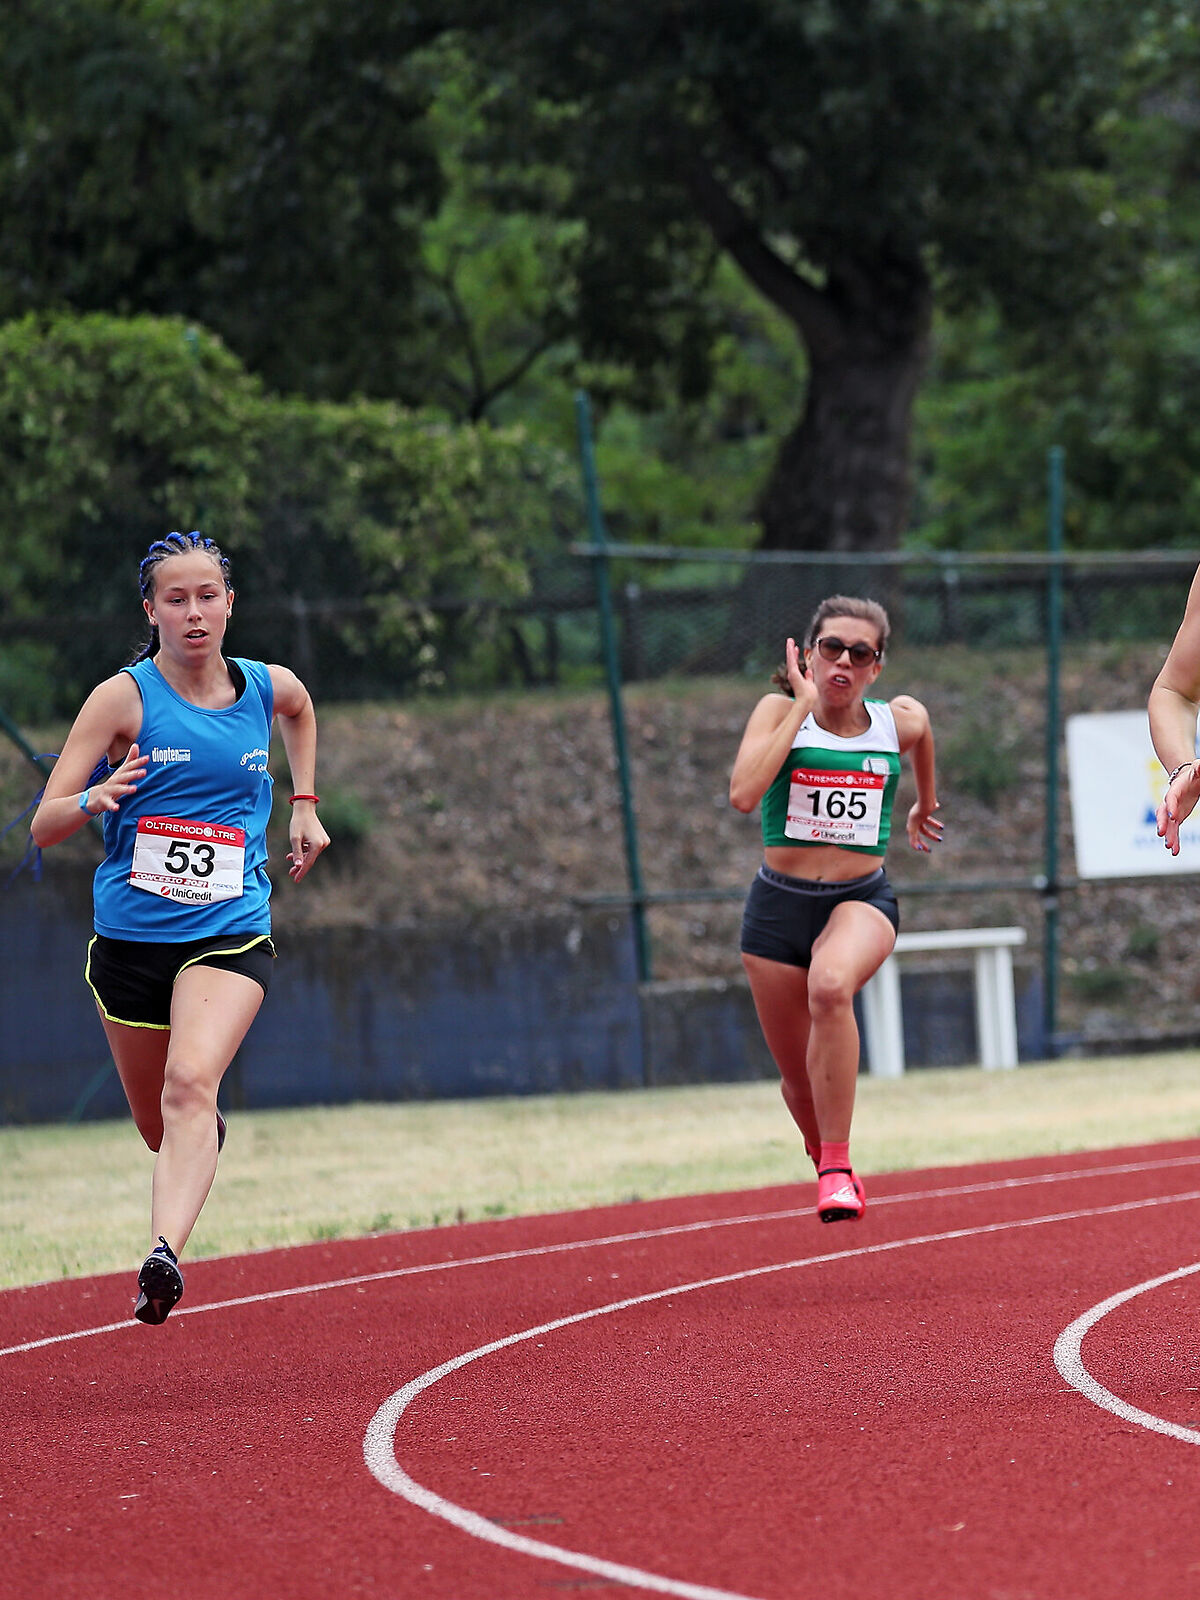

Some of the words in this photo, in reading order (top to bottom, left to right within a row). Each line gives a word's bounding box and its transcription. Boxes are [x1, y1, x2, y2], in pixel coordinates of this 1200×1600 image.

[807, 790, 867, 820] 165
[164, 840, 216, 878] 53
[171, 887, 213, 902] UniCredit
